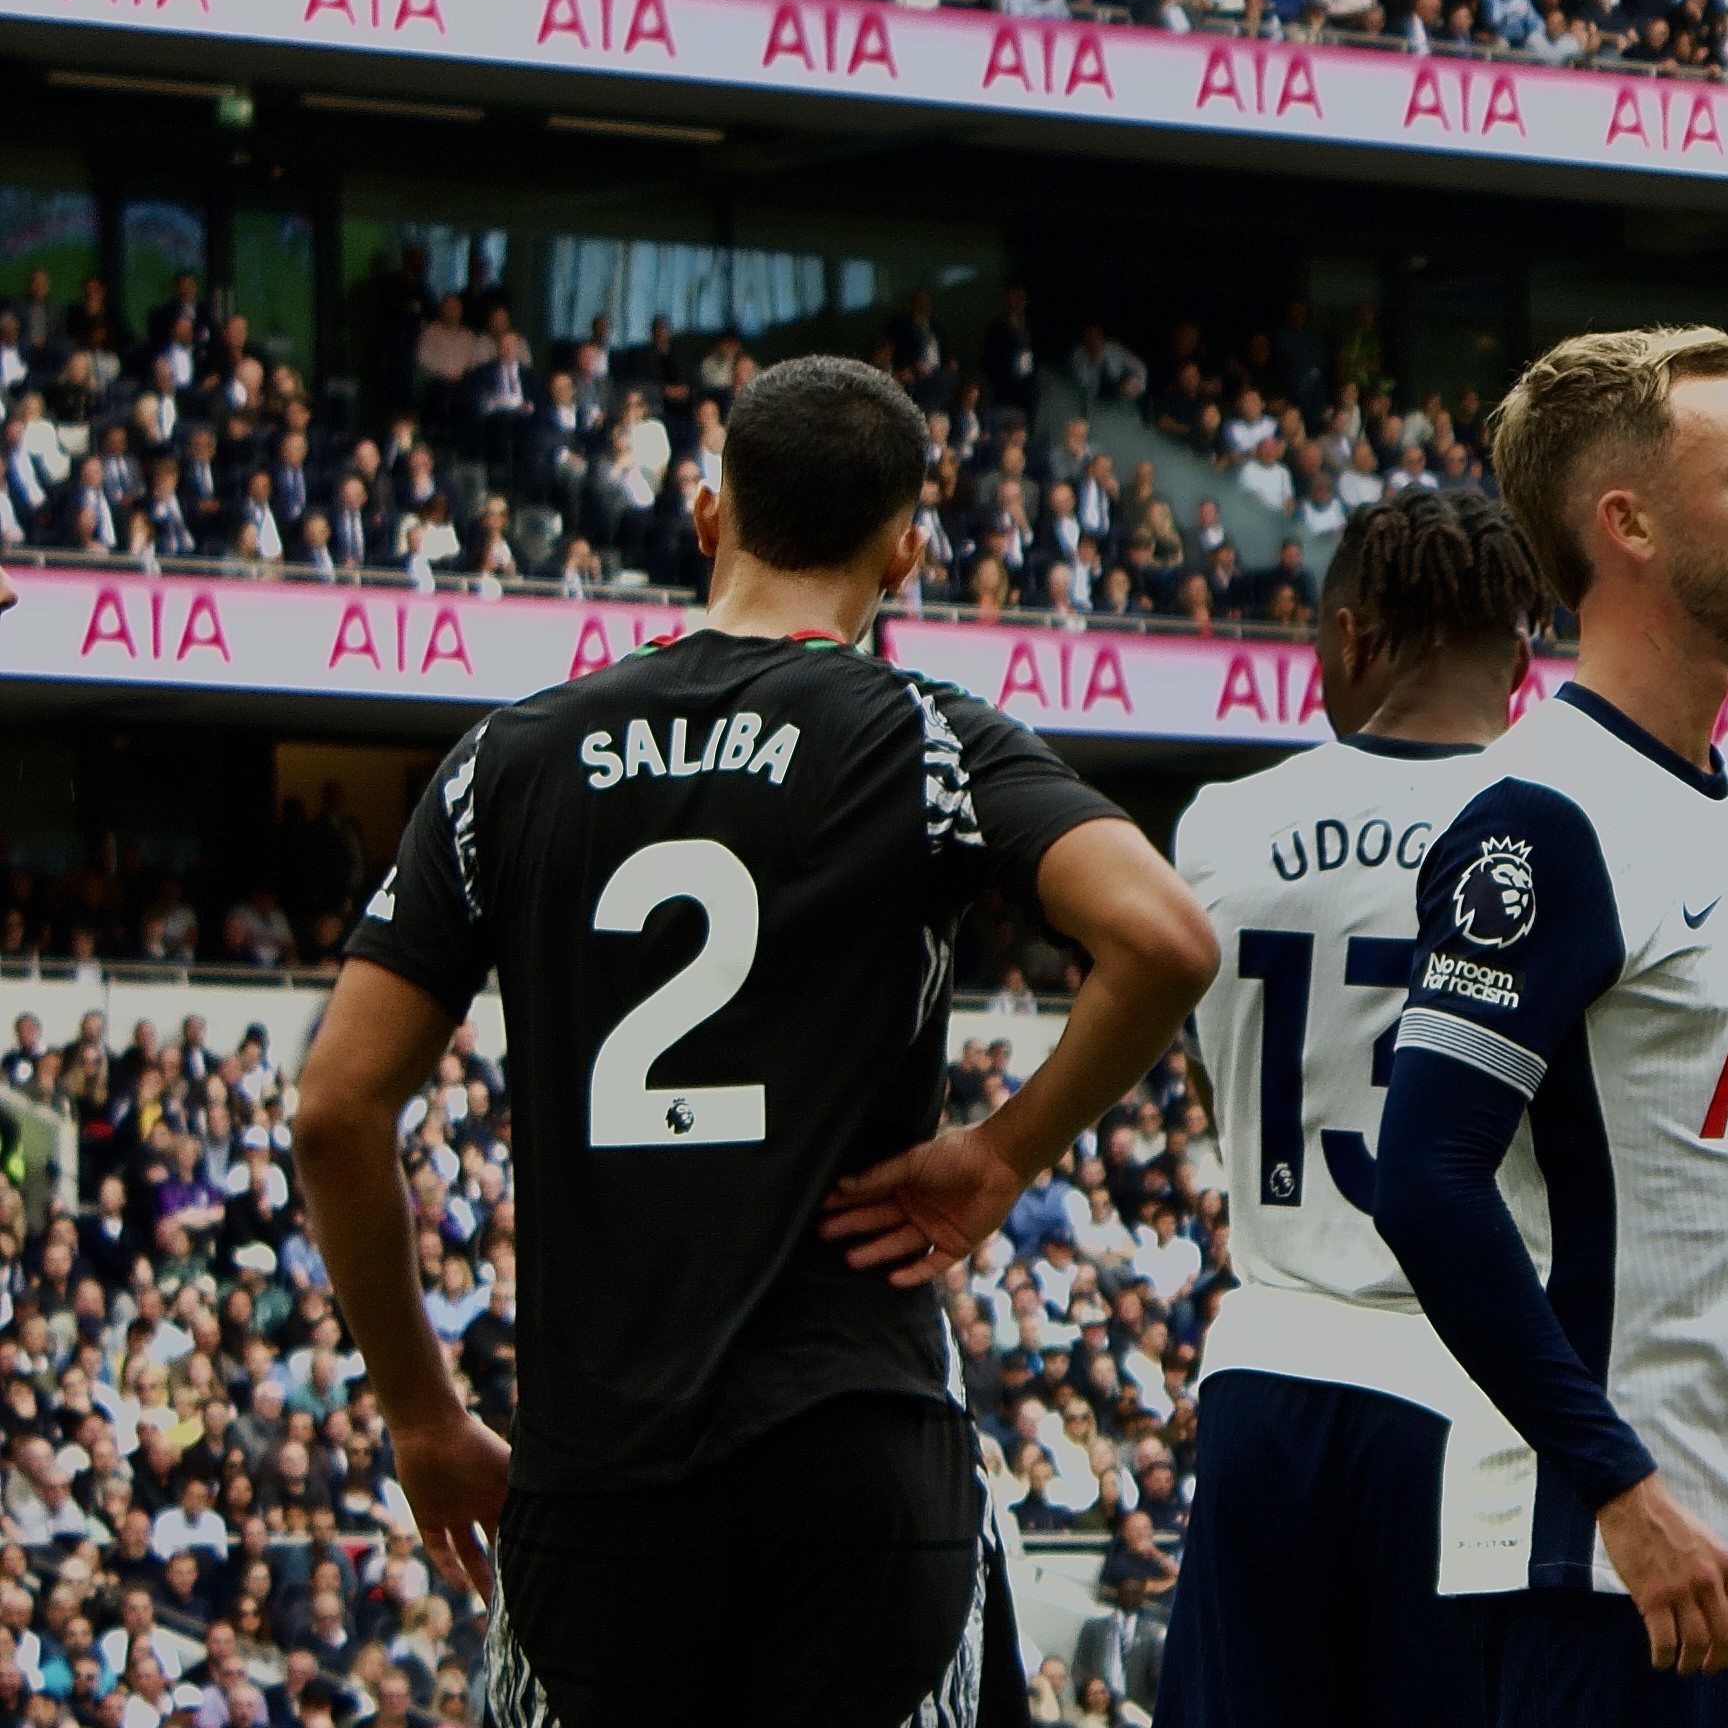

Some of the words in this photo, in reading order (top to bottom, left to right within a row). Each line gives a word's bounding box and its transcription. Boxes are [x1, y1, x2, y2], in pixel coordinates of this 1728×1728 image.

[761, 1, 898, 80] AIA
[982, 22, 1116, 101] AIA
[1197, 43, 1325, 122] AIA
[1404, 69, 1527, 139] AIA
[1606, 84, 1724, 156] AIA
[81, 586, 231, 663] AIA
[328, 601, 472, 674] AIA
[568, 612, 686, 682] AI
[997, 641, 1134, 714] AIA
[581, 712, 800, 788] SALIBA
[591, 838, 766, 1148] 2
[1427, 952, 1455, 975] No
[1455, 960, 1513, 990] room
[1448, 975, 1520, 1009] racism
